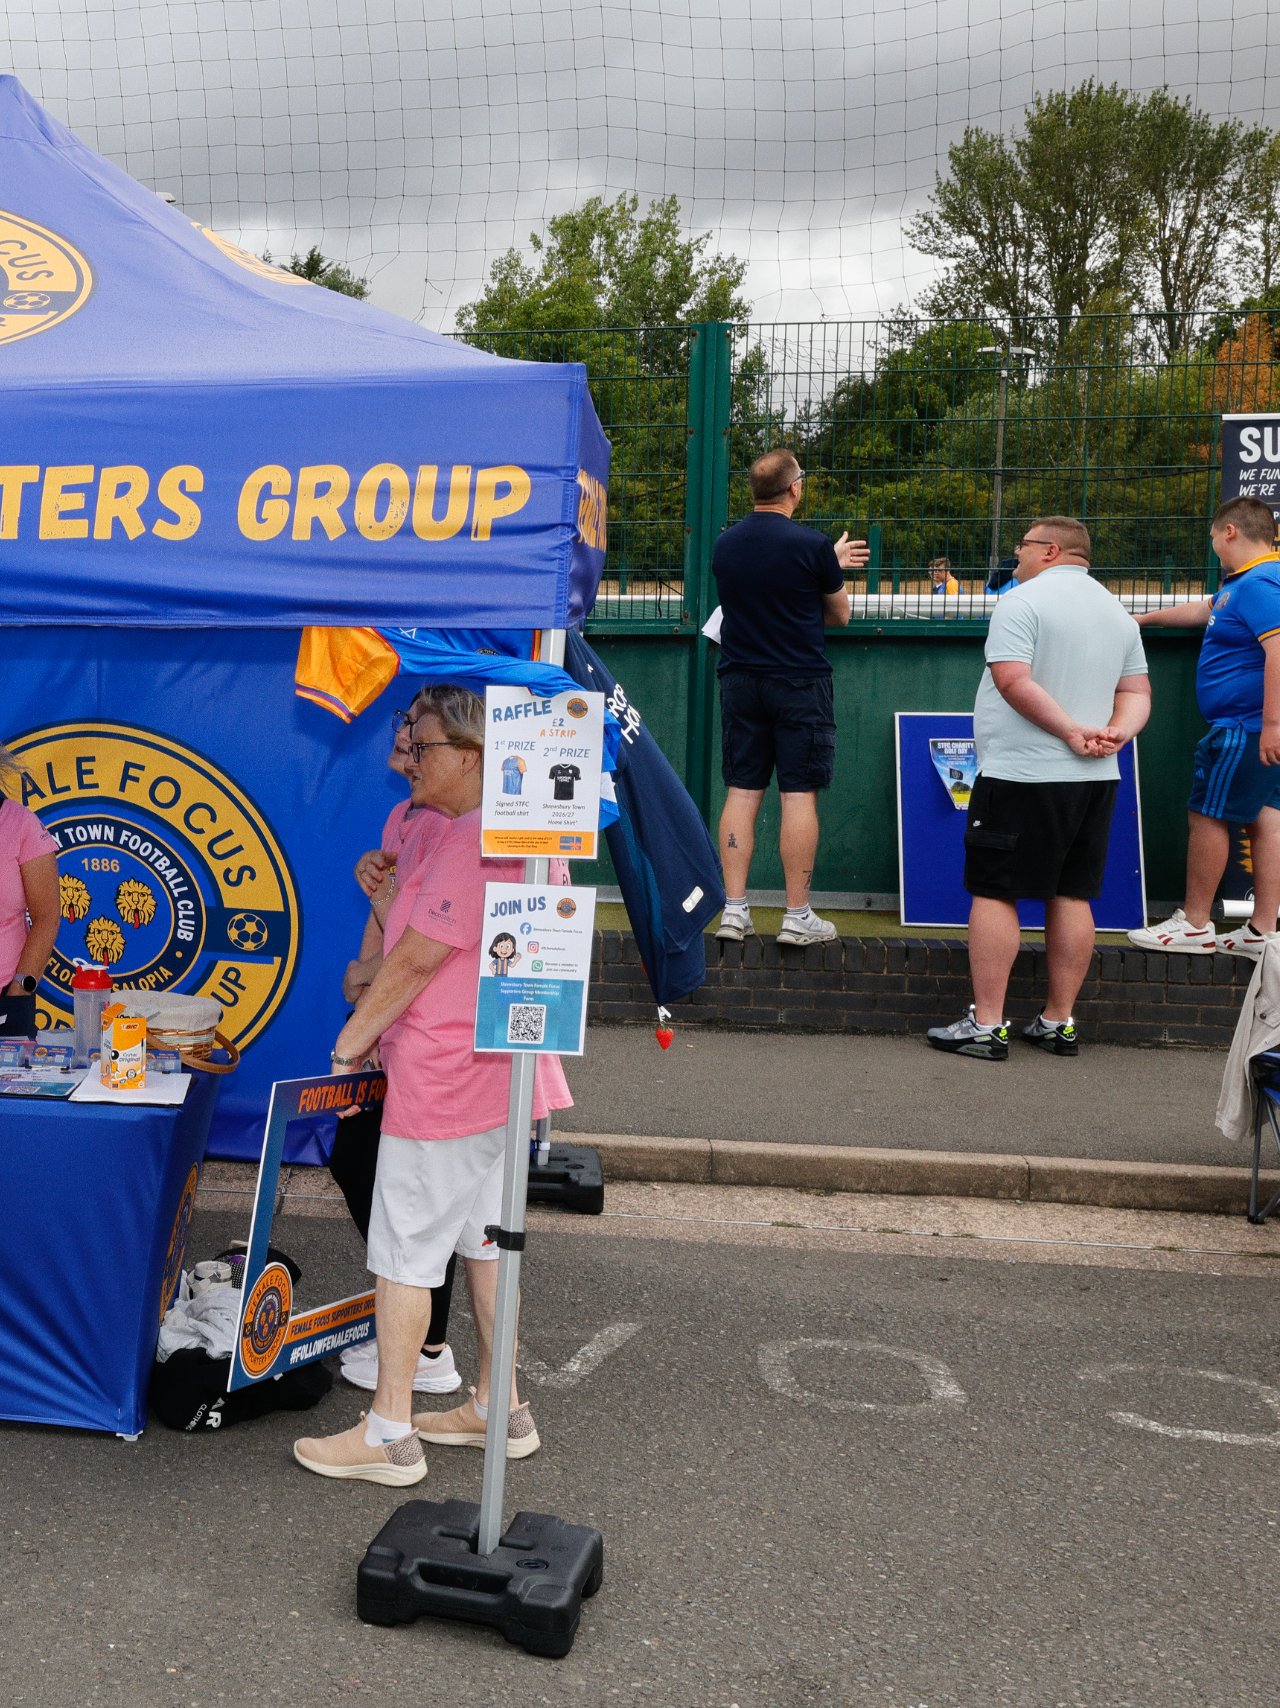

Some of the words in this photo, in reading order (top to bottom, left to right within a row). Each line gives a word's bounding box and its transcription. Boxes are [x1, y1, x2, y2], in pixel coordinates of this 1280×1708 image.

[1239, 468, 1257, 480] WE
[1239, 484, 1276, 496] WE'RE
[239, 464, 530, 540] GROUP
[492, 700, 552, 723] RAFFLE
[552, 717, 564, 727] £2
[540, 729, 546, 737] A
[549, 728, 577, 738] STRIP
[507, 741, 536, 751] PRIZE
[559, 748, 591, 758] PRIZE
[20, 756, 99, 806] ALE
[118, 761, 257, 888] FOCUS
[81, 857, 120, 873] 1886
[64, 824, 114, 844] TOWN
[119, 829, 189, 898] FOOTBALL
[177, 899, 195, 942] CLUB
[490, 899, 521, 918] JOIN
[527, 896, 546, 912] US
[298, 1082, 353, 1114] FOOTBALL
[355, 1080, 368, 1104] IS
[291, 1319, 313, 1336] FEMALE
[313, 1314, 331, 1328] FOCUS
[331, 1303, 363, 1322] SUPPORTERS
[290, 1321, 370, 1365] #FOLLOWFEMALEFOCUS
